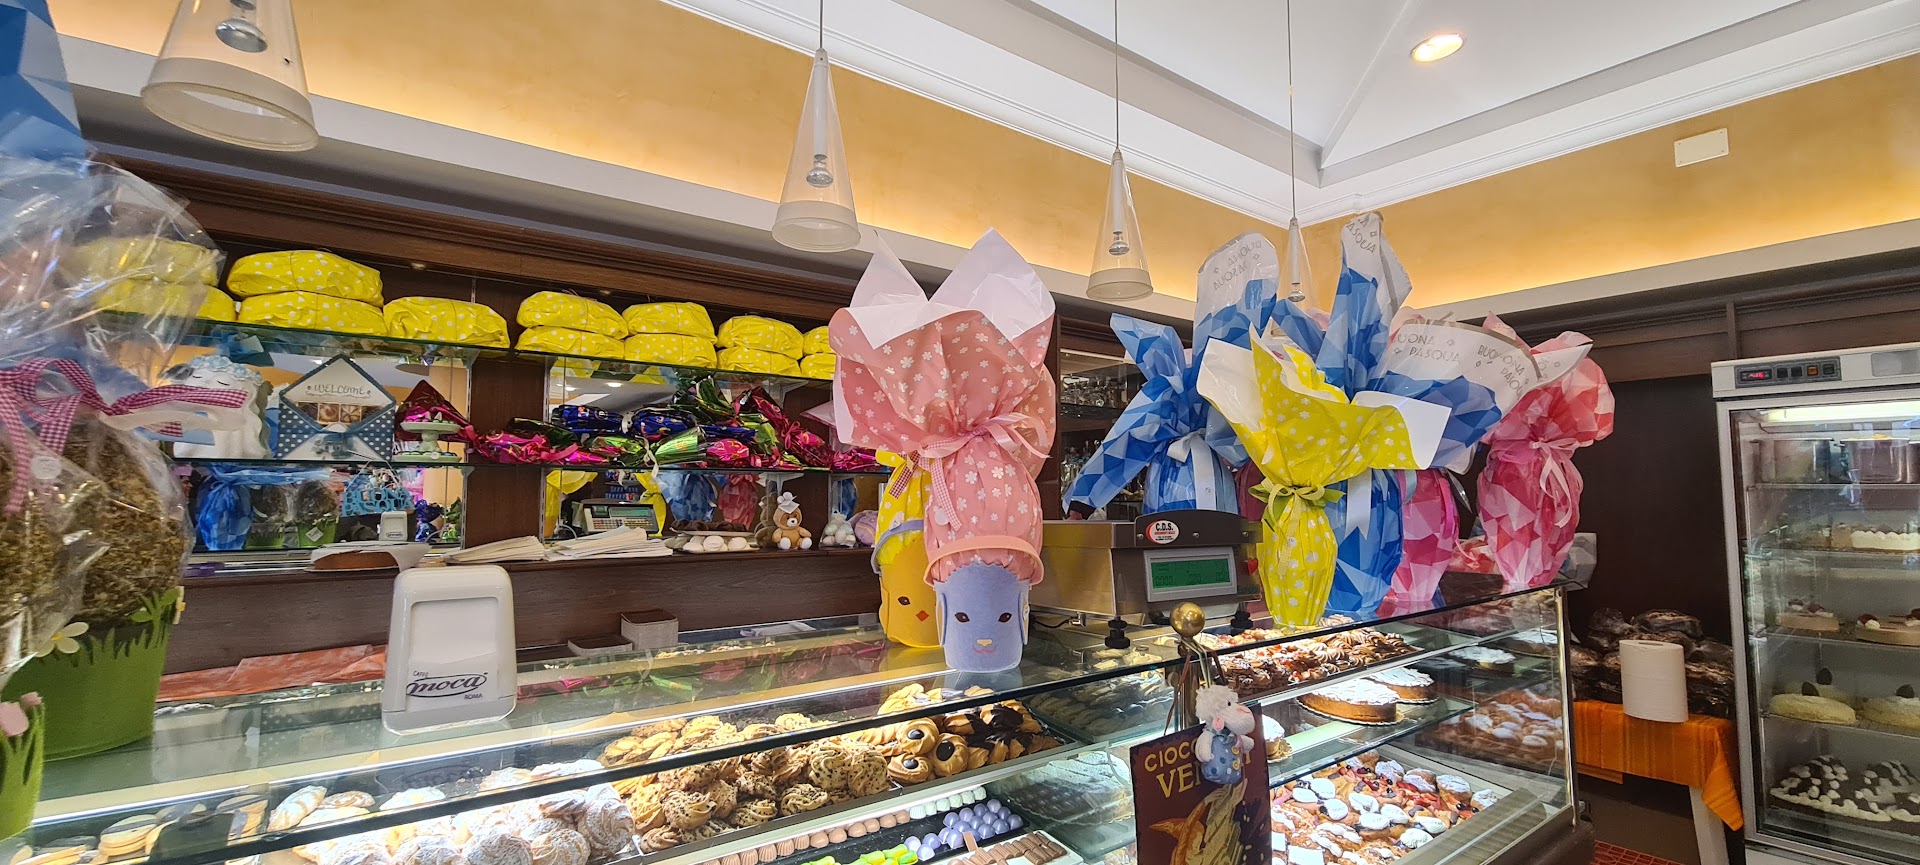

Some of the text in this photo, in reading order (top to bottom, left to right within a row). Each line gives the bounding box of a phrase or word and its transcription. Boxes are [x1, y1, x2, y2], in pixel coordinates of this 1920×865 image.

[1346, 222, 1376, 253] ASQUA
[1397, 333, 1434, 345] UONA
[1409, 346, 1460, 362] PASQUA
